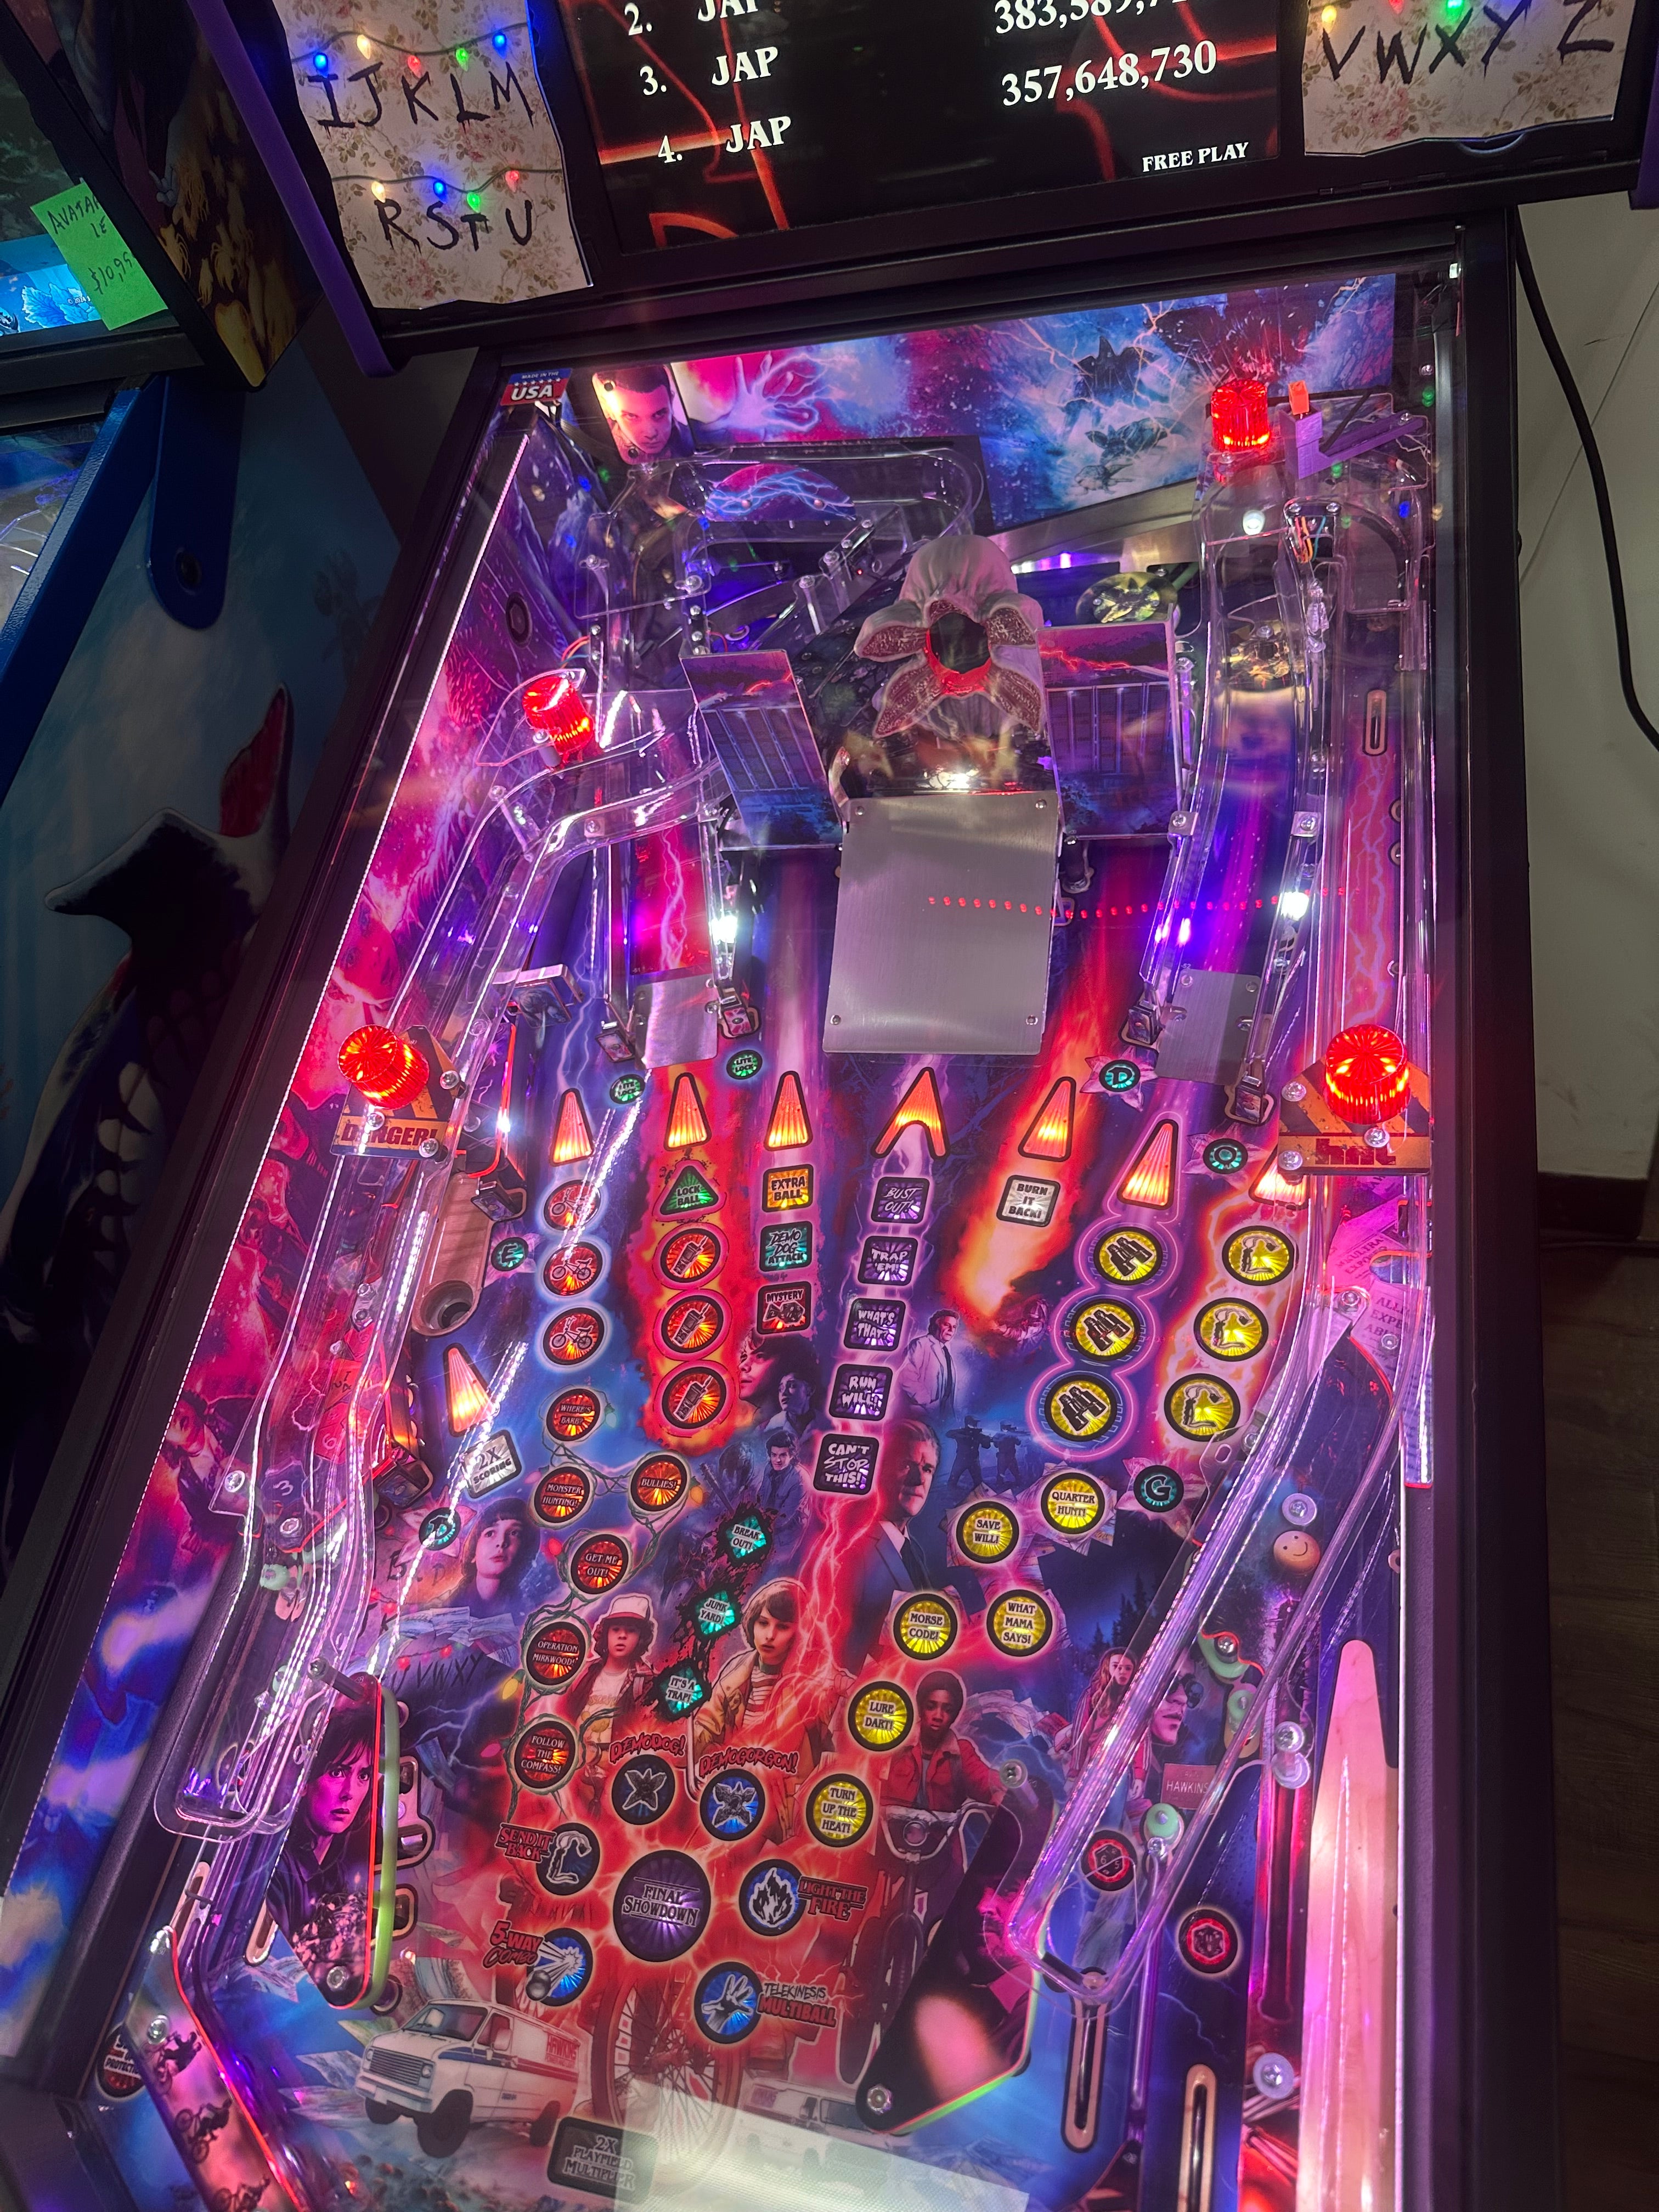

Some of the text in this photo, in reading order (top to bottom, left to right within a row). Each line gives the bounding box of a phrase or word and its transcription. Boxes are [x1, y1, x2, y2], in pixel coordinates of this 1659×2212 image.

[624, 3, 653, 36] 2.
[640, 40, 1217, 106] 3. JAP 357,648,730
[657, 116, 792, 163] 4. JAP
[1142, 142, 1249, 172] FREE PLAY
[91, 216, 106, 238] LE
[511, 385, 553, 401] USA
[735, 1063, 754, 1073] LOCK
[736, 1056, 753, 1066] LITE
[1111, 1067, 1133, 1086] D
[341, 1123, 438, 1146] DNGER!
[676, 1184, 701, 1195] LOCK
[771, 1176, 805, 1190] EXTRA
[1017, 1183, 1048, 1196] BURN
[774, 1189, 803, 1201] BALL
[884, 1186, 922, 1200] BUST
[677, 1195, 701, 1206] BALL
[884, 1199, 912, 1214] OUT!
[1023, 1196, 1032, 1205] IT
[1008, 1205, 1042, 1219] BACK!
[771, 1229, 802, 1246] DEMO
[501, 1244, 518, 1262] E
[774, 1242, 796, 1255] DOG
[768, 1251, 804, 1264] ATTACK
[871, 1250, 909, 1262] TRAP
[766, 1289, 804, 1302] MYSTERY
[857, 1308, 895, 1325] WHAT'S
[857, 1323, 888, 1339] THAT?
[849, 1375, 877, 1392] RUN
[840, 1390, 880, 1409] WILL!
[561, 1404, 592, 1413] WHERE'S
[561, 1417, 584, 1425] BARB?
[828, 1442, 870, 1455] CAN'T
[477, 1446, 505, 1471] 2X
[823, 1455, 870, 1472] STOP
[473, 1458, 512, 1485] SCORING
[826, 1470, 863, 1485] THIS!
[546, 1484, 582, 1494] MONSTER
[641, 1479, 677, 1489] BULLIES!
[1144, 1474, 1172, 1499] G
[542, 1496, 578, 1507] HUNTING!
[1051, 1492, 1096, 1504] QUARTER
[1057, 1505, 1086, 1517] HUNT!
[977, 1519, 1001, 1531] SAVE
[733, 1526, 759, 1540] BREAK
[974, 1532, 1000, 1544] WILL!
[732, 1538, 753, 1550] OUT!
[585, 1554, 618, 1565] GET ME
[587, 1568, 608, 1577] OUT!
[706, 1599, 728, 1611] JUNK
[1007, 1602, 1036, 1615] WHAT
[699, 1611, 724, 1623] YARD!
[910, 1612, 943, 1624] MORSE
[1005, 1617, 1034, 1629] MAMA
[909, 1627, 939, 1640] CODE!
[1003, 1631, 1031, 1644] SAYS!
[537, 1640, 578, 1652] OPERATION
[533, 1653, 577, 1666] MIRKWOOD!
[670, 1677, 687, 1687] IT'S
[667, 1689, 691, 1700] TRAP!
[869, 1702, 894, 1714] LURE
[865, 1717, 893, 1730] DART!
[531, 1736, 565, 1748] FOLLOW
[610, 1734, 685, 1763] DEMODOG!
[537, 1748, 553, 1759] THE
[521, 1759, 561, 1774] COMPASS!
[699, 1748, 799, 1778] DEMOGORGON!
[1166, 1779, 1209, 1794] HAWKINS
[830, 1787, 856, 1801] TURN
[822, 1803, 857, 1818] UP THE
[821, 1820, 851, 1833] HEAT!
[498, 1827, 552, 1851] SEND IT
[506, 1845, 541, 1861] BACK
[644, 1885, 683, 1905] FINAL
[800, 1878, 866, 1903] LIGHT THE
[623, 1896, 699, 1927] SHOWDOWN
[808, 1898, 851, 1921] FIRE
[490, 1921, 543, 1951] 5-WAY
[764, 1982, 827, 2000] TELEKINESIS
[757, 1993, 836, 2027] MULTIBALL
[596, 2136, 617, 2152] 2X
[573, 2148, 634, 2171] PLAYFIELD
[563, 2159, 636, 2190] MULTIPLIER
